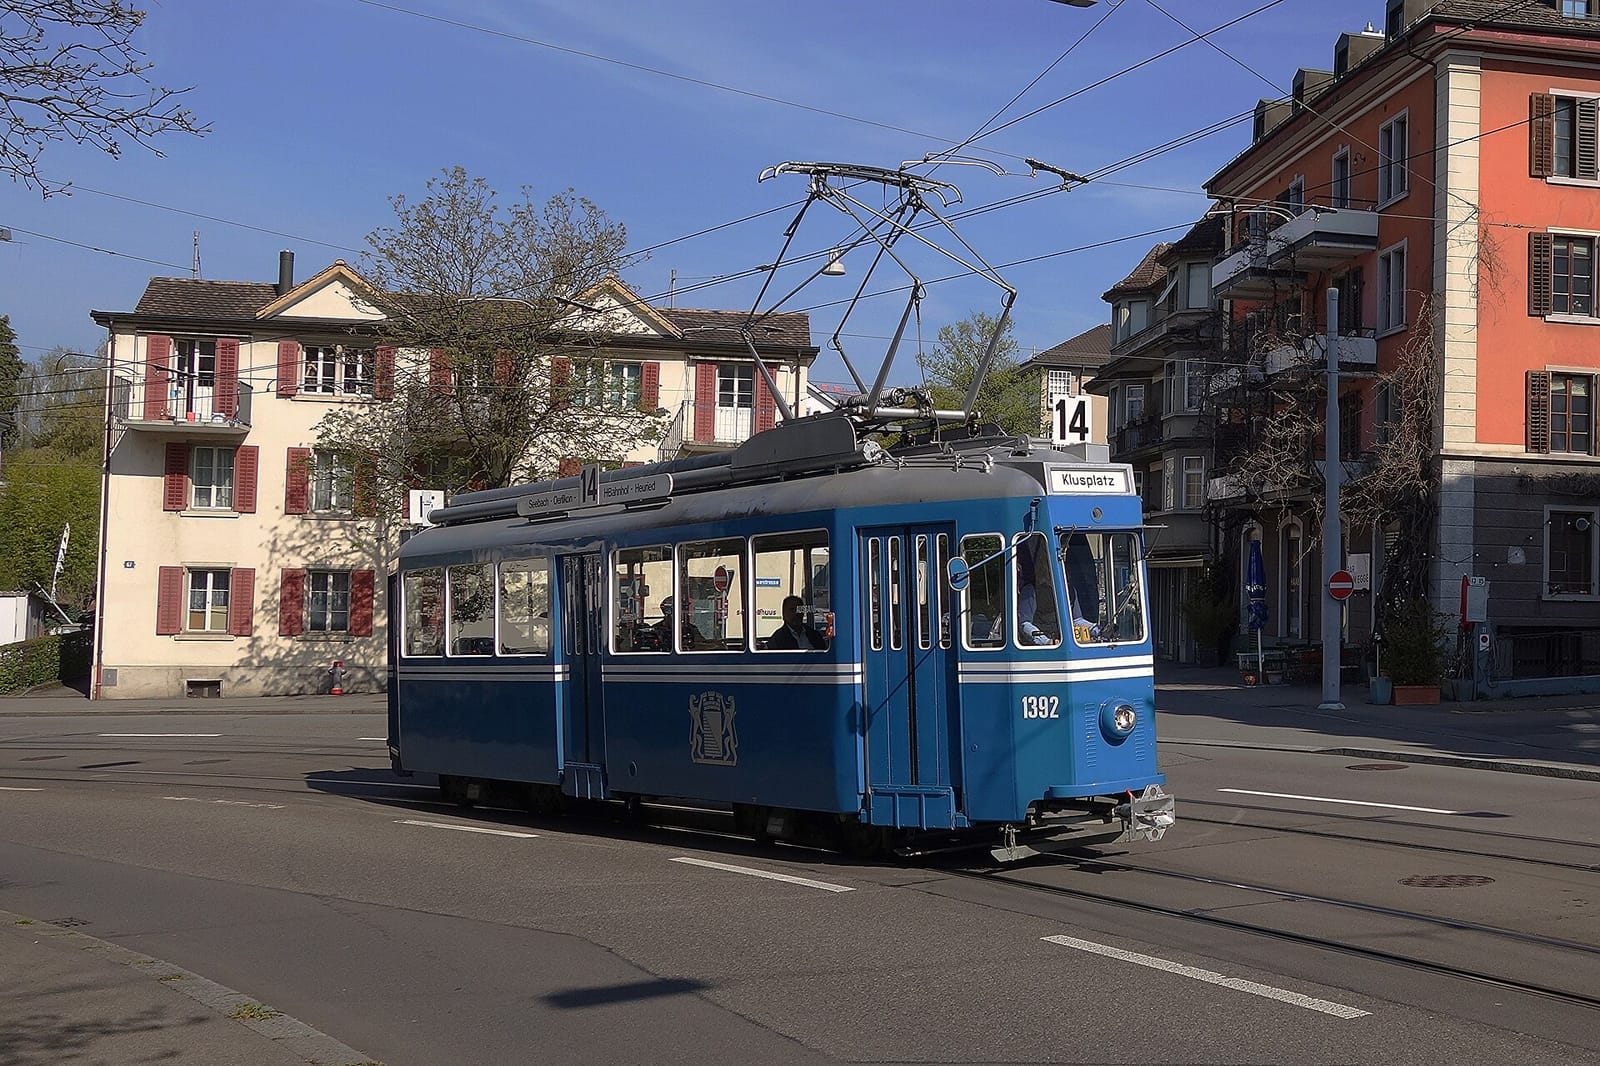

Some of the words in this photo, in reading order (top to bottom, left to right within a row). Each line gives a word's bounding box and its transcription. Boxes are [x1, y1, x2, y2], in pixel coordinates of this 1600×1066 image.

[1056, 399, 1088, 441] 14
[580, 468, 598, 503] 14
[634, 481, 656, 492] Heuried
[1062, 473, 1115, 488] Klusplatz
[528, 498, 550, 509] Seebach
[1021, 696, 1059, 719] 1392
